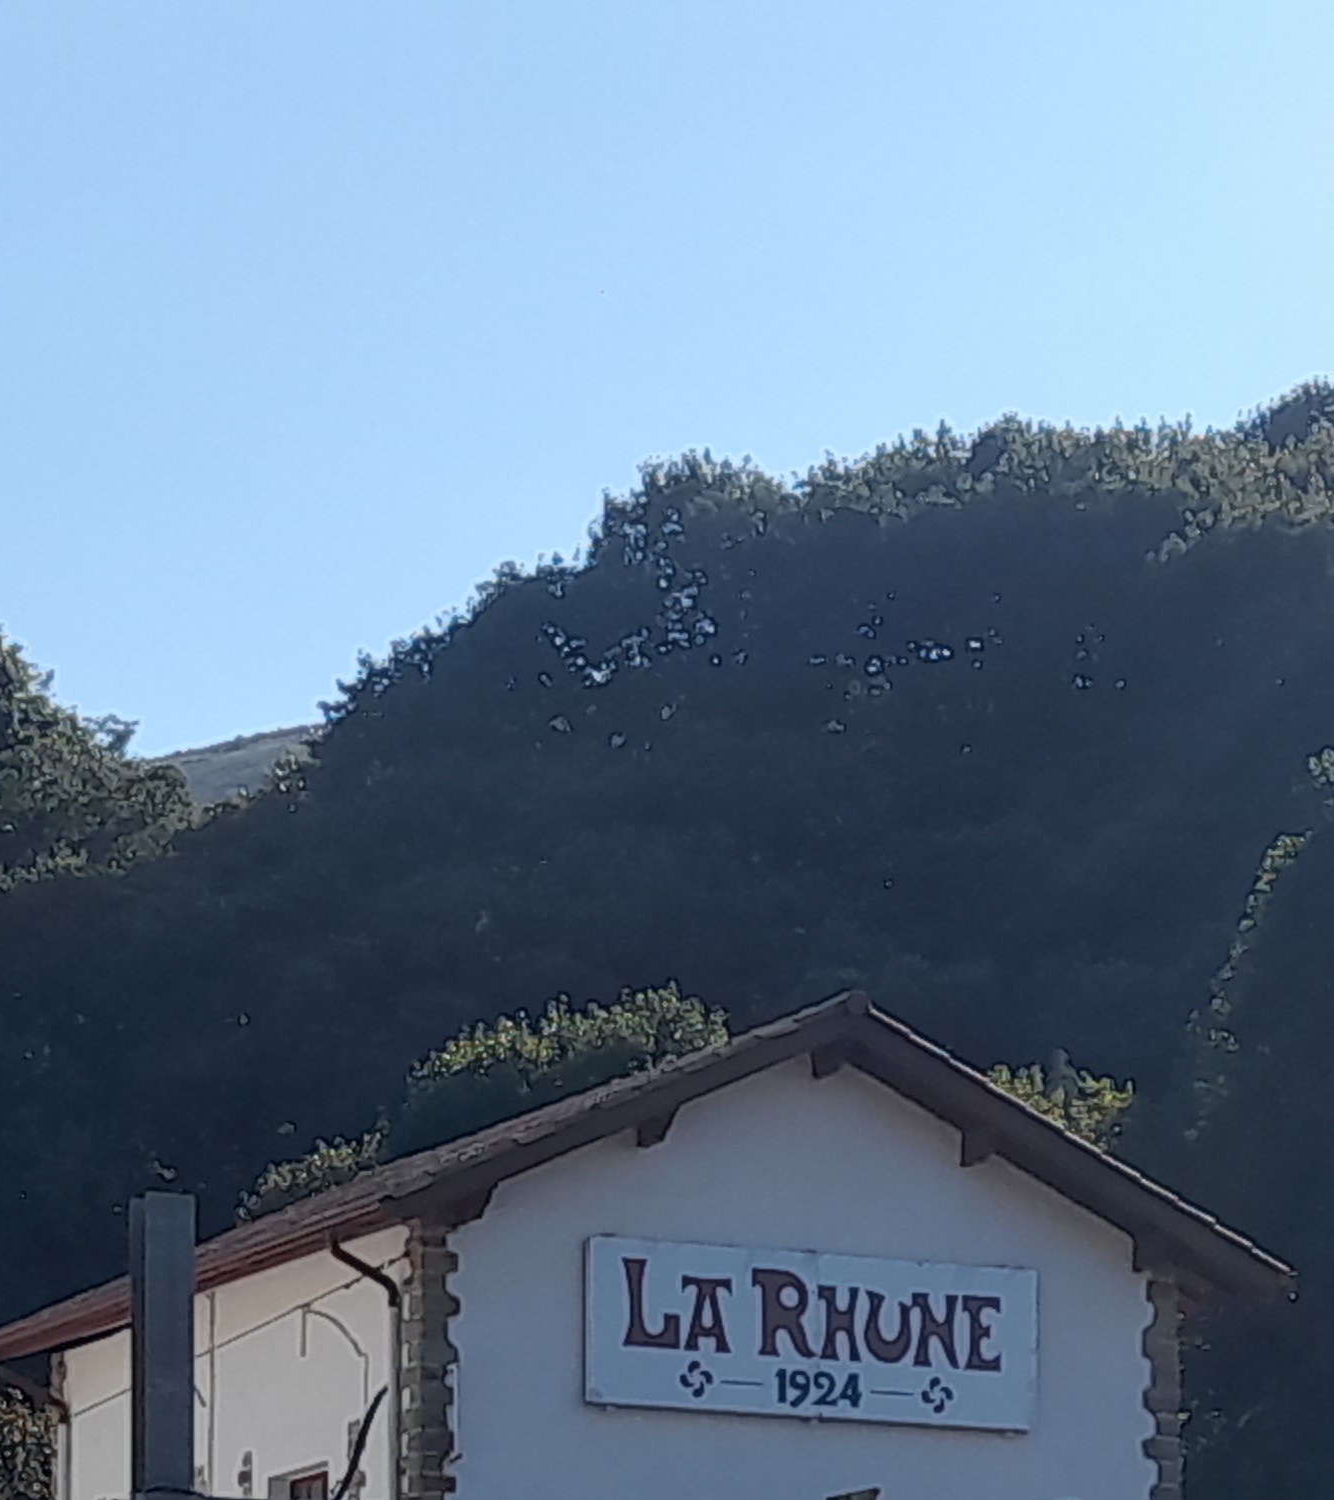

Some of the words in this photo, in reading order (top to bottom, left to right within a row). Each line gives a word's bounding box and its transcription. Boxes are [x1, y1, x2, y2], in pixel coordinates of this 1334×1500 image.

[621, 1257, 732, 1354] LA
[752, 1267, 1002, 1372] RHUNE
[774, 1368, 862, 1408] 1924
